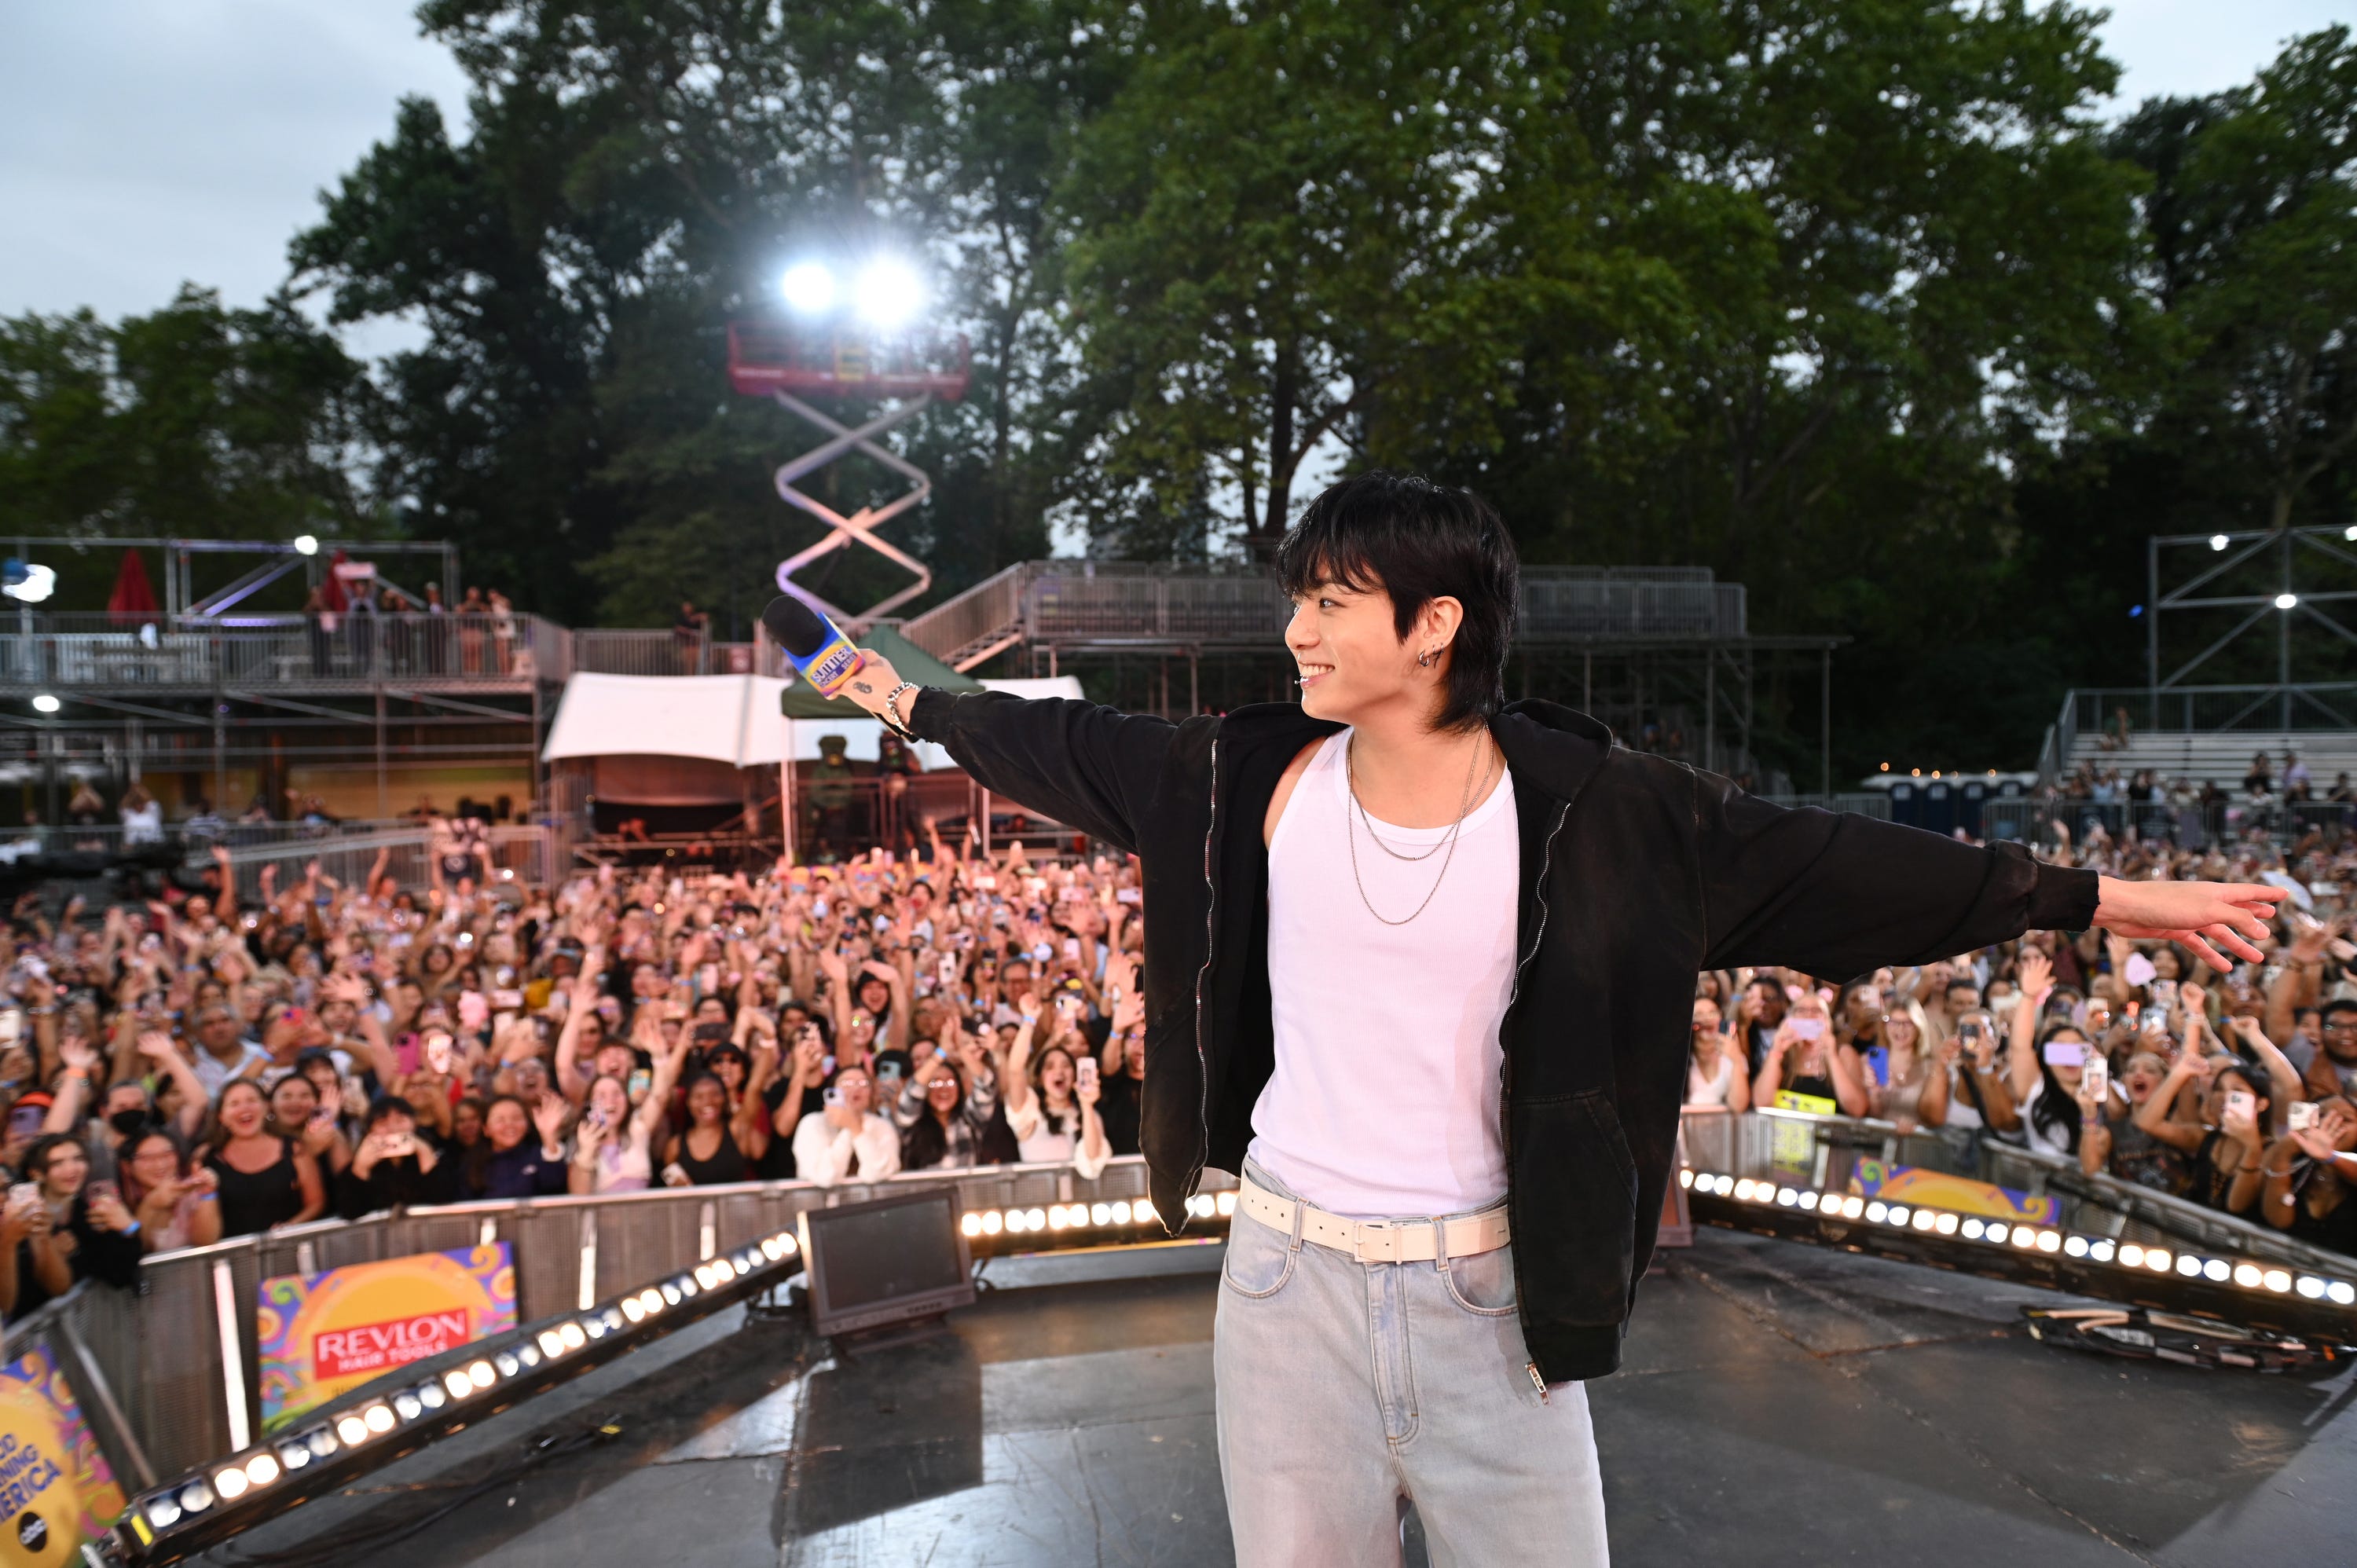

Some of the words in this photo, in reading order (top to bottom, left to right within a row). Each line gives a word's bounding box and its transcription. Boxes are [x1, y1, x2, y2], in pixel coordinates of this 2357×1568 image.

[812, 647, 850, 681] SUMMER
[317, 1310, 466, 1362] REVLON
[338, 1350, 385, 1373] HAIR
[387, 1340, 449, 1363] TOOLS
